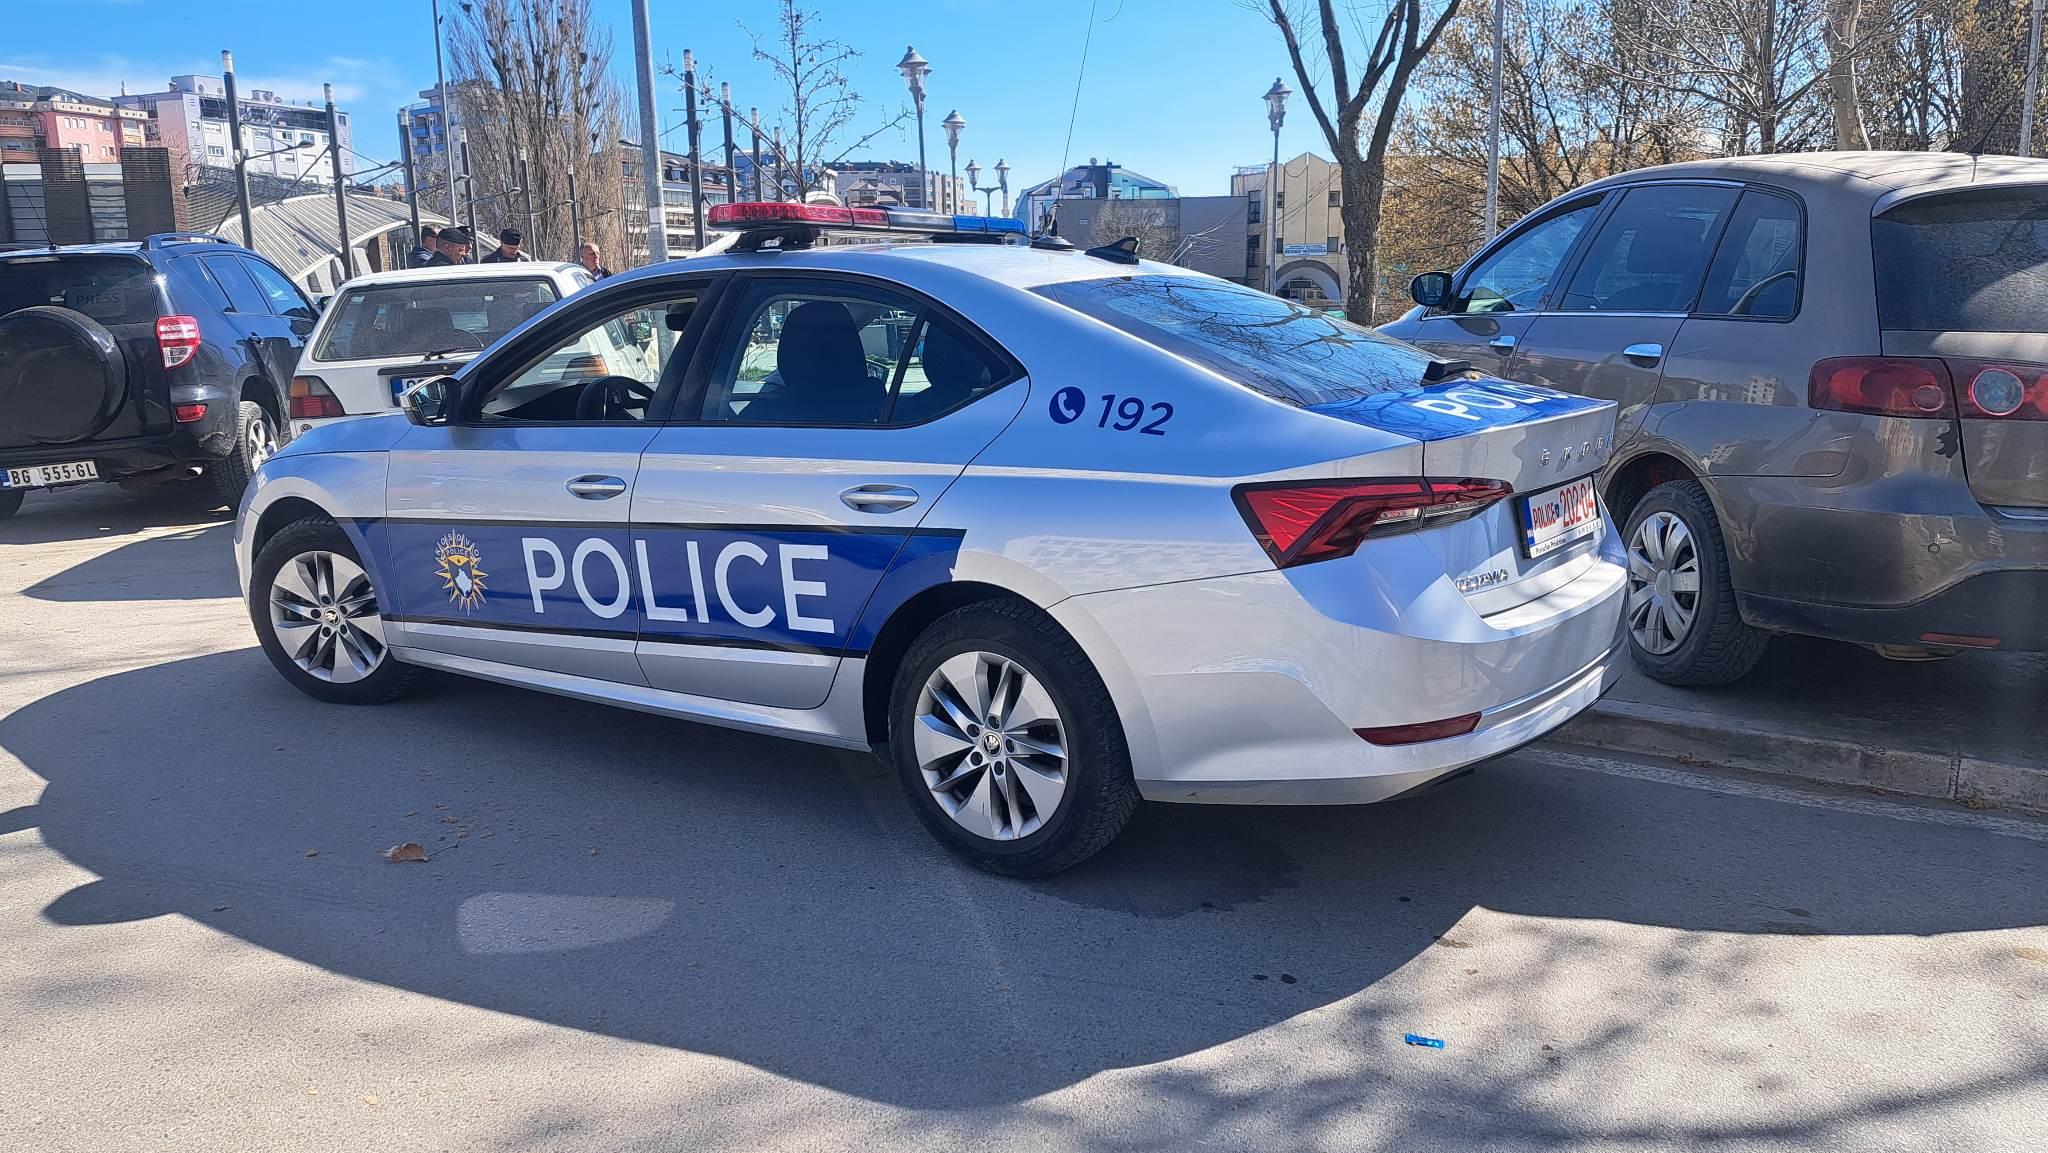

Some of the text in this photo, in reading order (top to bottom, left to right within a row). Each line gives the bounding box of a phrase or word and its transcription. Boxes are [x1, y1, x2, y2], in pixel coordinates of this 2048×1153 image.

[76, 293, 120, 304] PRESS
[1098, 394, 1174, 436] 192
[11, 470, 31, 485] BG
[1532, 502, 1556, 532] POLICE
[435, 533, 480, 557] KOSOVO
[446, 549, 469, 557] POLICE
[521, 537, 835, 634] POLICE
